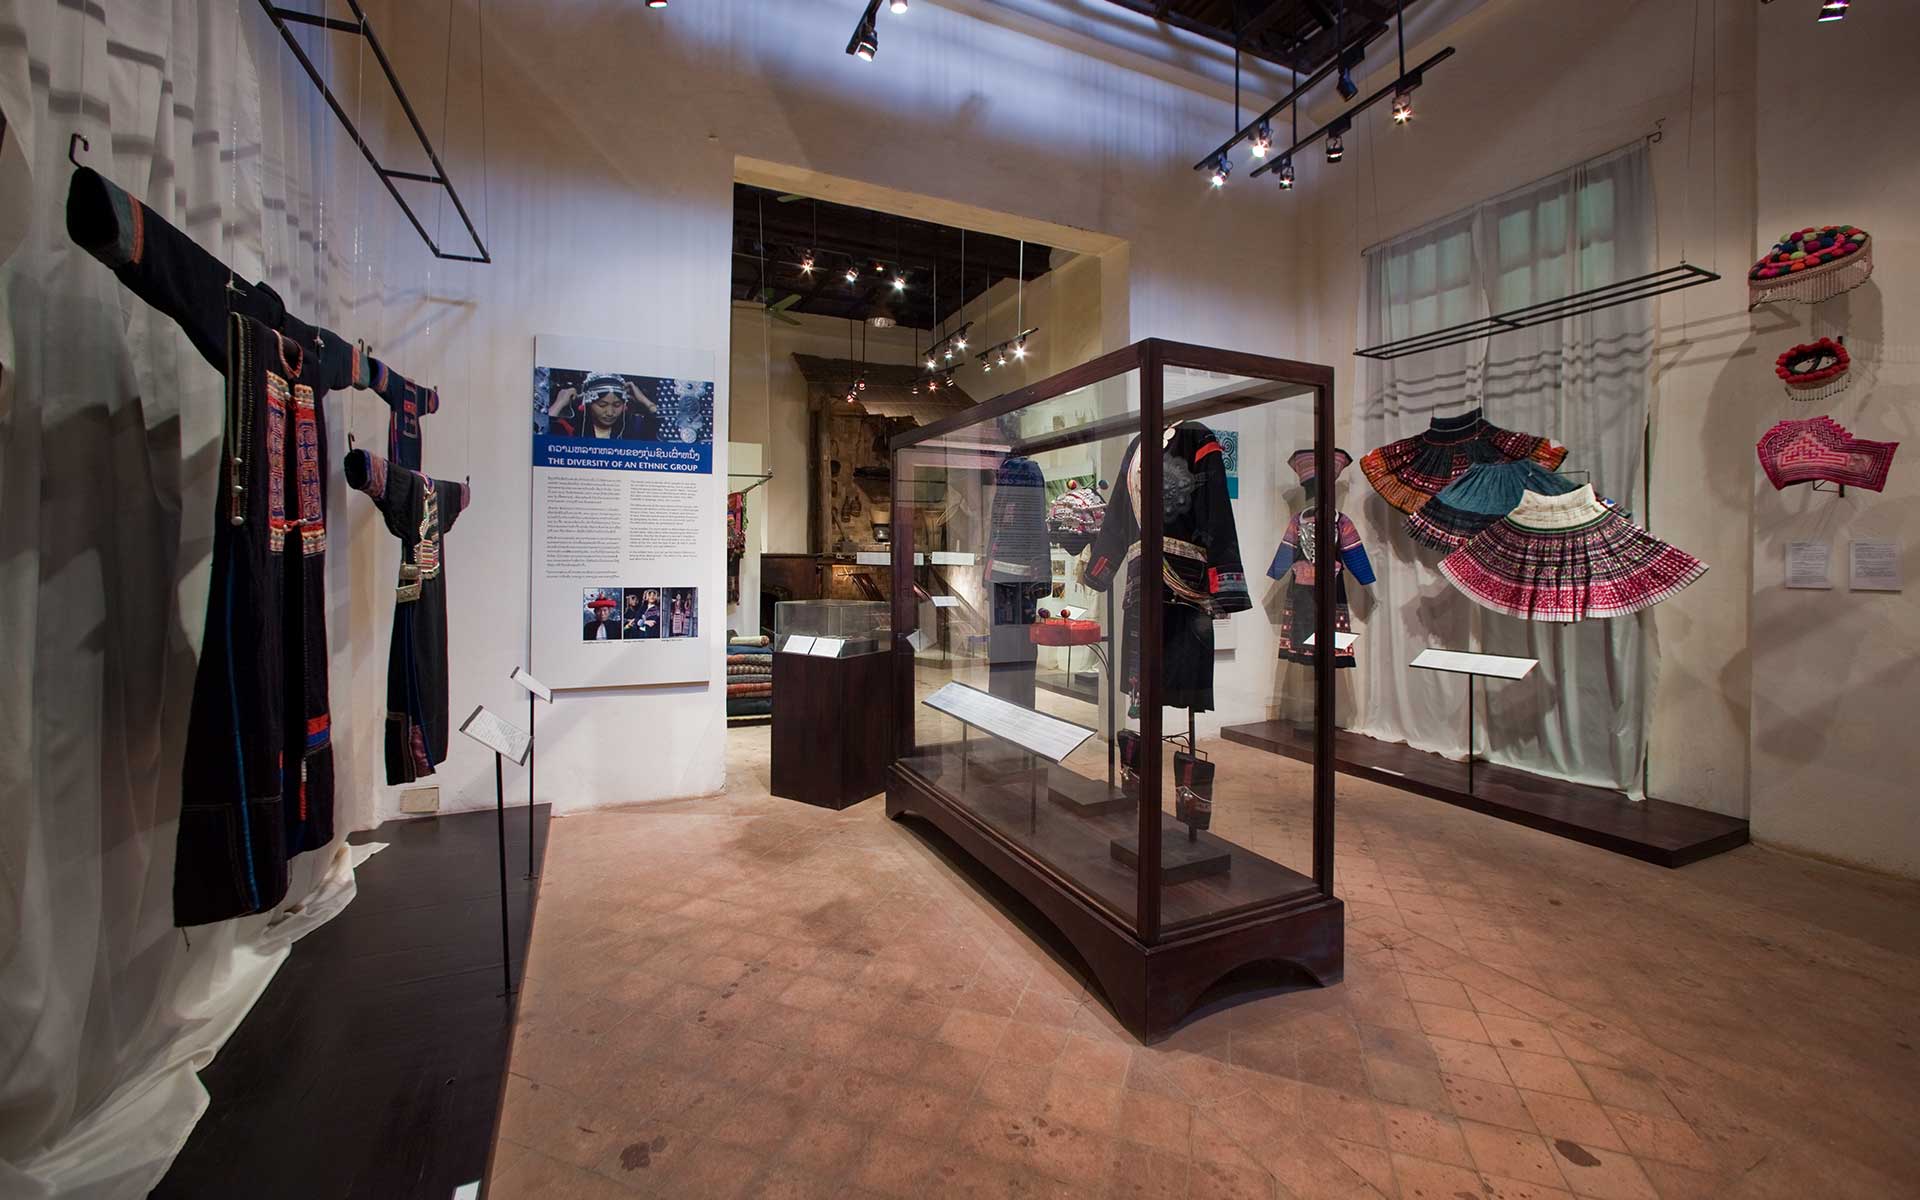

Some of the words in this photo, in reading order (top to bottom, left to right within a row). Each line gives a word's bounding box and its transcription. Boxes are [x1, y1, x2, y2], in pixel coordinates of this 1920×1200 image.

[548, 457, 565, 465] THE
[567, 458, 609, 467] DIVERSITY
[611, 460, 623, 468] OF
[639, 462, 669, 470] ETHNIC
[670, 463, 698, 472] GROUP
